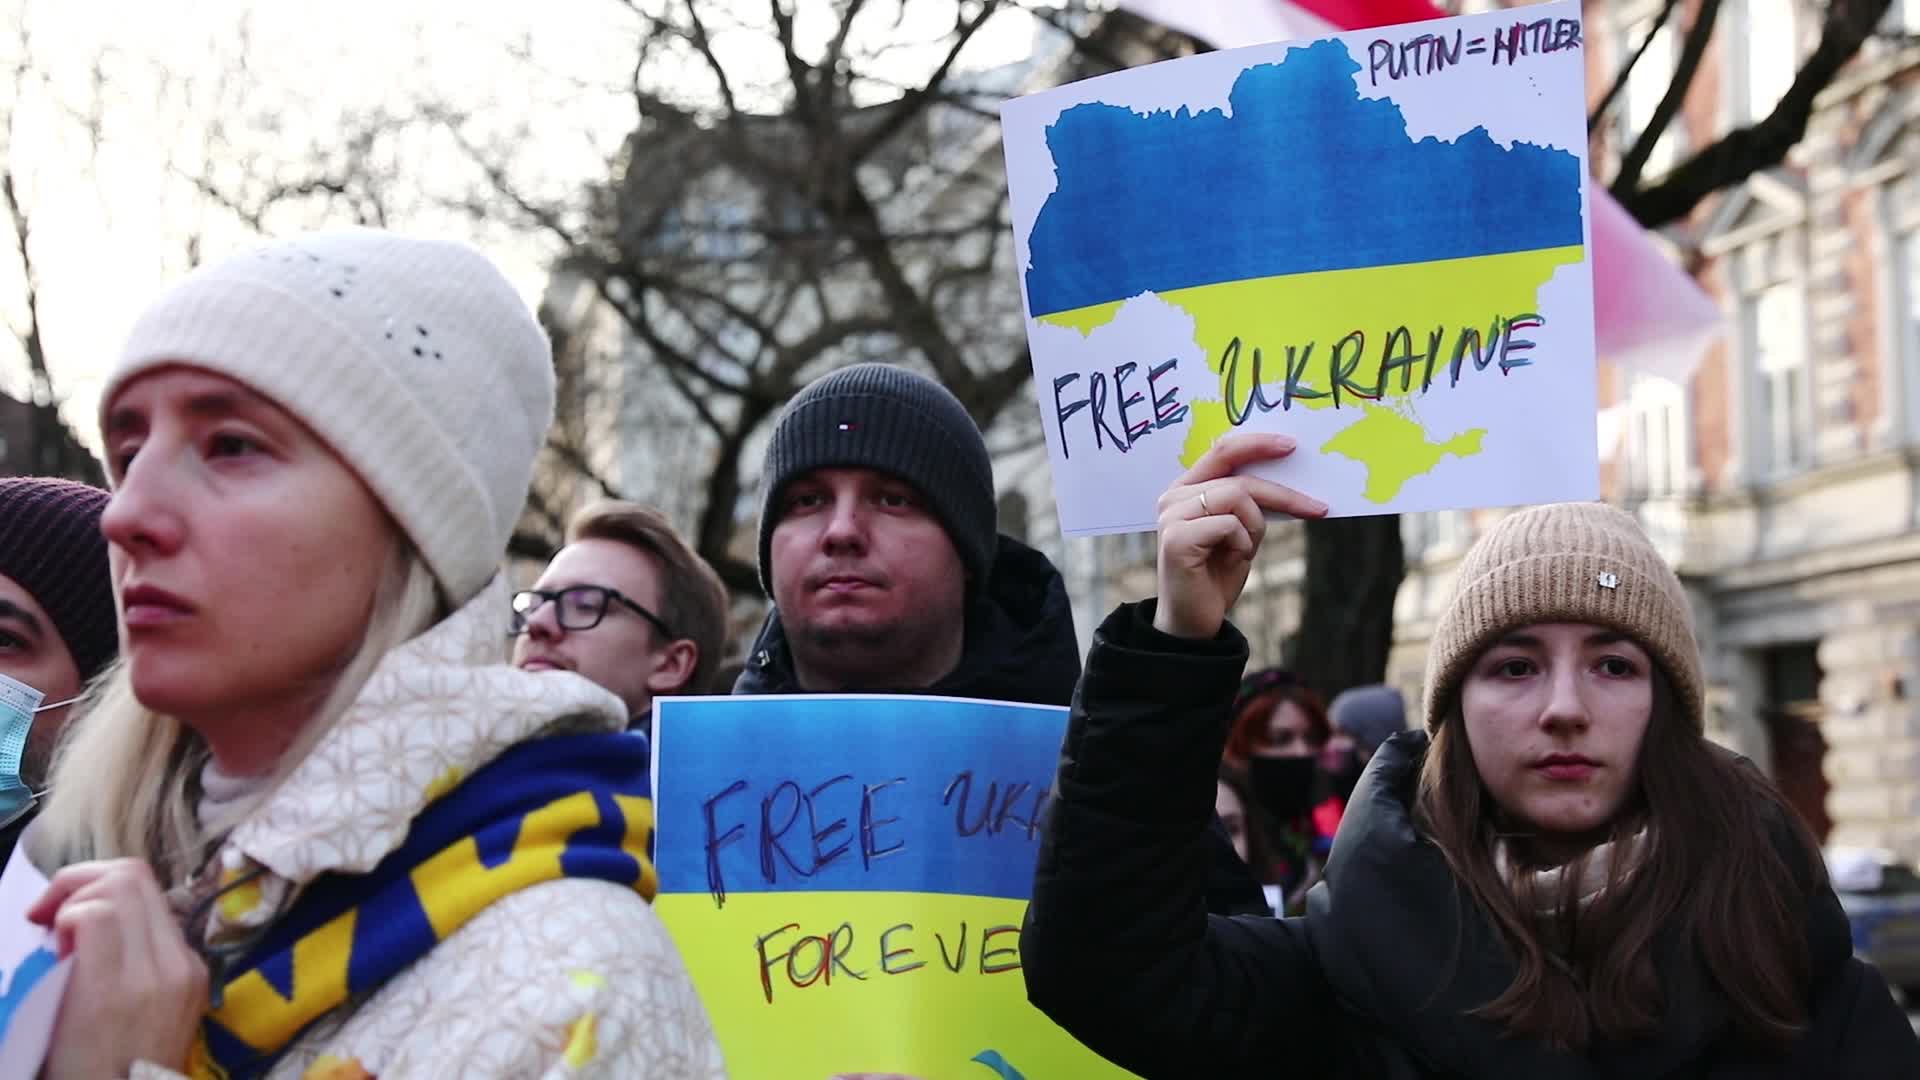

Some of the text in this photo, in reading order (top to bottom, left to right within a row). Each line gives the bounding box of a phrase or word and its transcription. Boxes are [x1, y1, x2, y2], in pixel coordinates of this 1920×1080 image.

[1054, 313, 1545, 459] FREE UKRAINE
[702, 775, 907, 909] FREE
